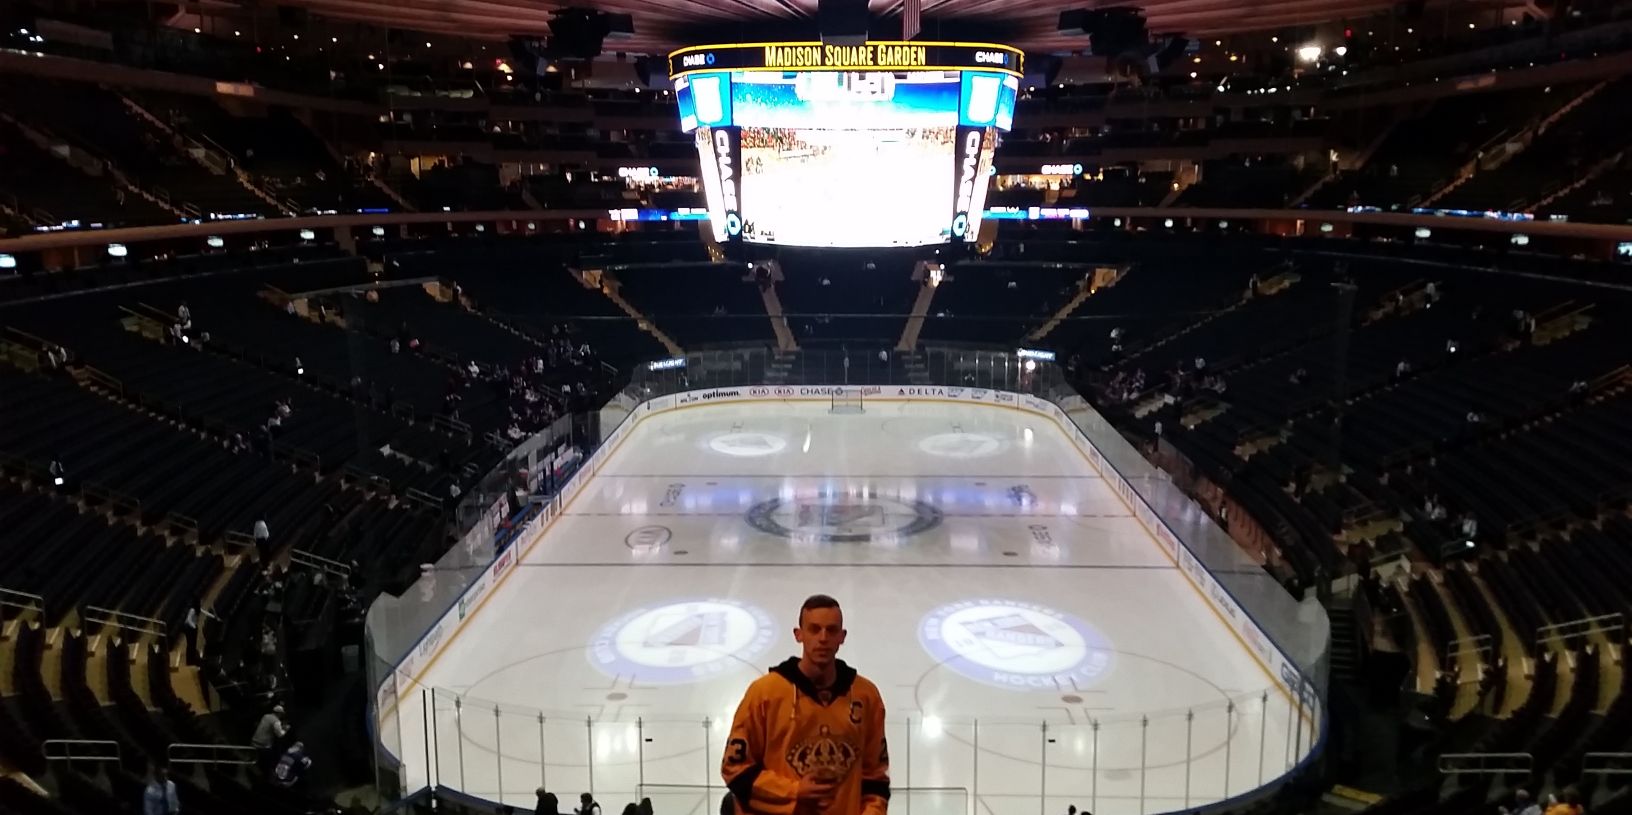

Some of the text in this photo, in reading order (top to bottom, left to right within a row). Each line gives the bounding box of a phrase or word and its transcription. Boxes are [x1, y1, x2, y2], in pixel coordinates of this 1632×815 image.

[765, 45, 926, 66] MADISON SQUARE GARDEN
[975, 51, 1004, 64] CHASE
[715, 129, 738, 211] CHASE
[956, 131, 981, 213] CHASE
[800, 387, 833, 396] CHASE
[908, 388, 944, 396] DELTA
[851, 701, 863, 724] C
